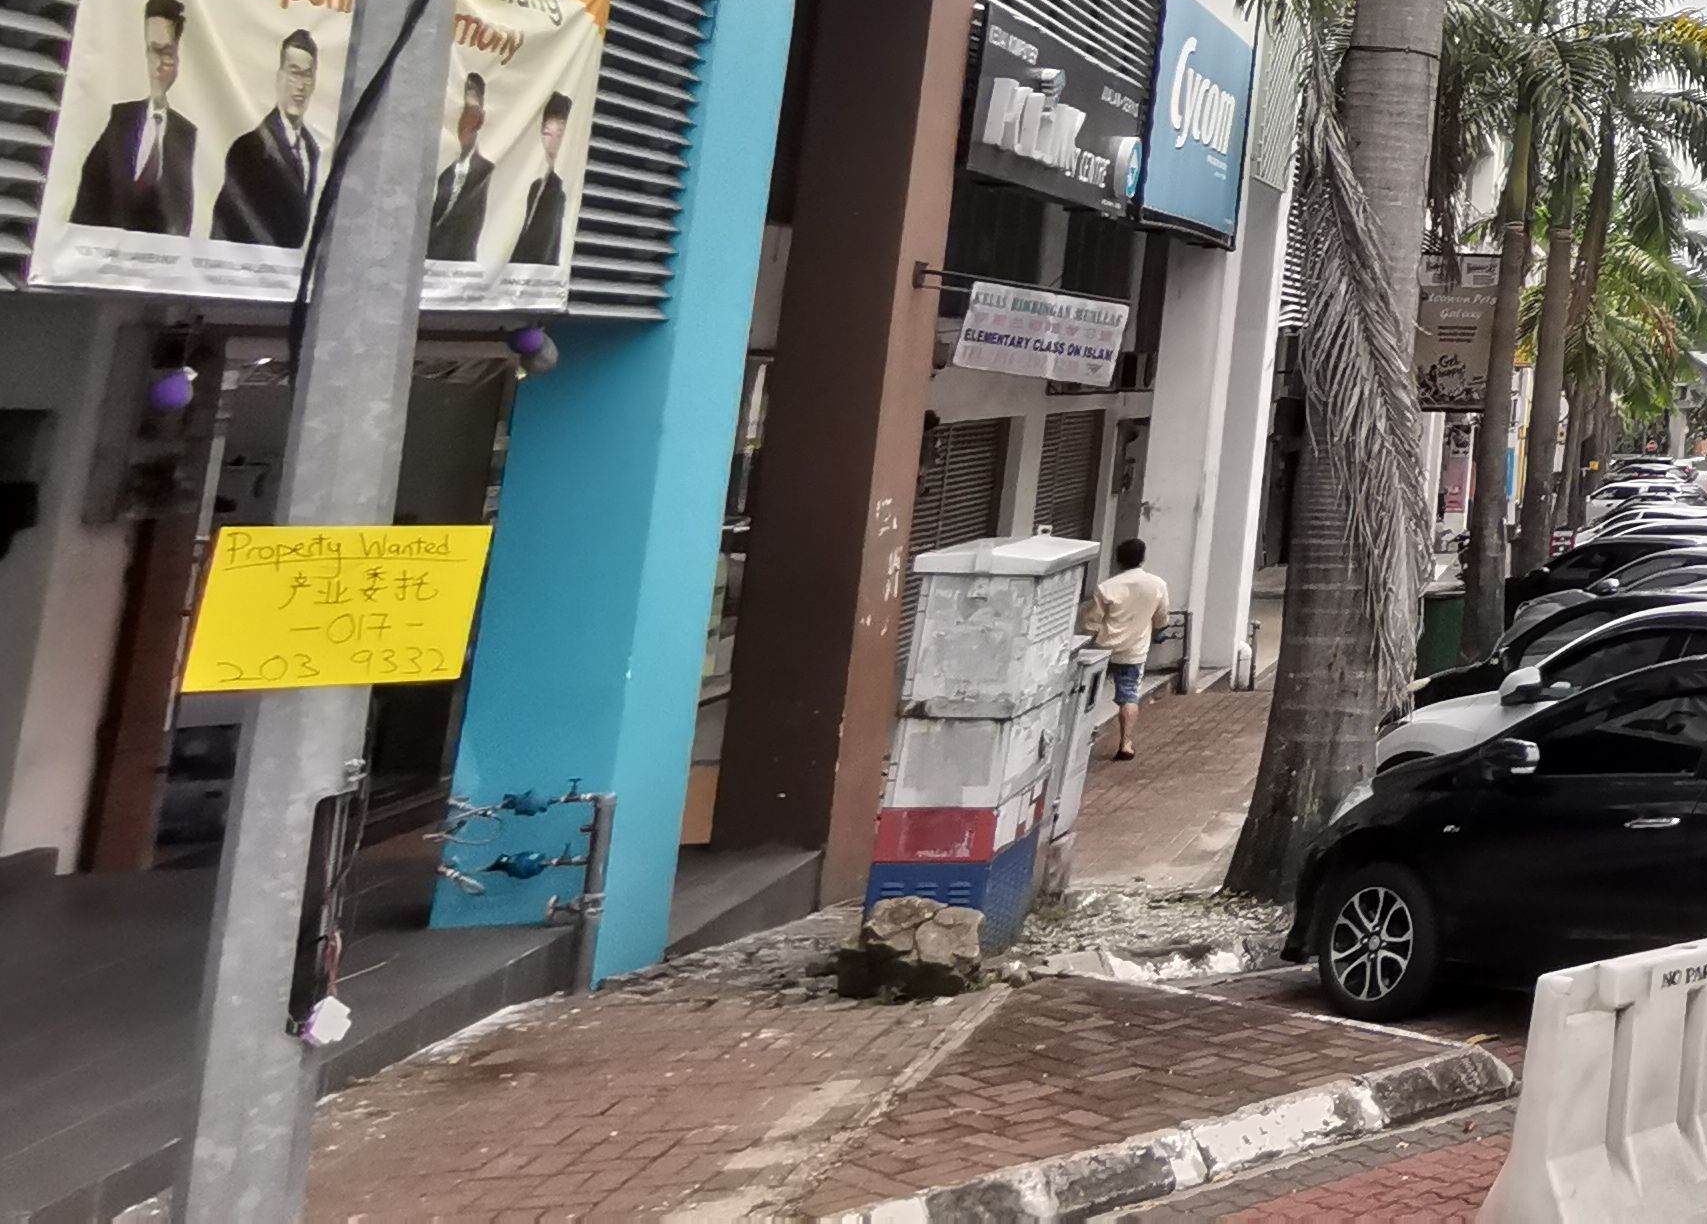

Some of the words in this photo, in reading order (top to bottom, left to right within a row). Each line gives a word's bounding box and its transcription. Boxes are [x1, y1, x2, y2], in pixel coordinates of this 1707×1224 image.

[454, 13, 524, 66] mony
[963, 327, 1030, 350] ELEMENTARY
[1033, 338, 1065, 355] CLASS
[1067, 343, 1082, 357] ON
[1084, 346, 1114, 362] ISLAM
[226, 531, 343, 579] Property
[360, 532, 452, 557] Wanted
[216, 653, 321, 682] 203
[349, 646, 449, 675] 9332
[1660, 969, 1683, 989] NO
